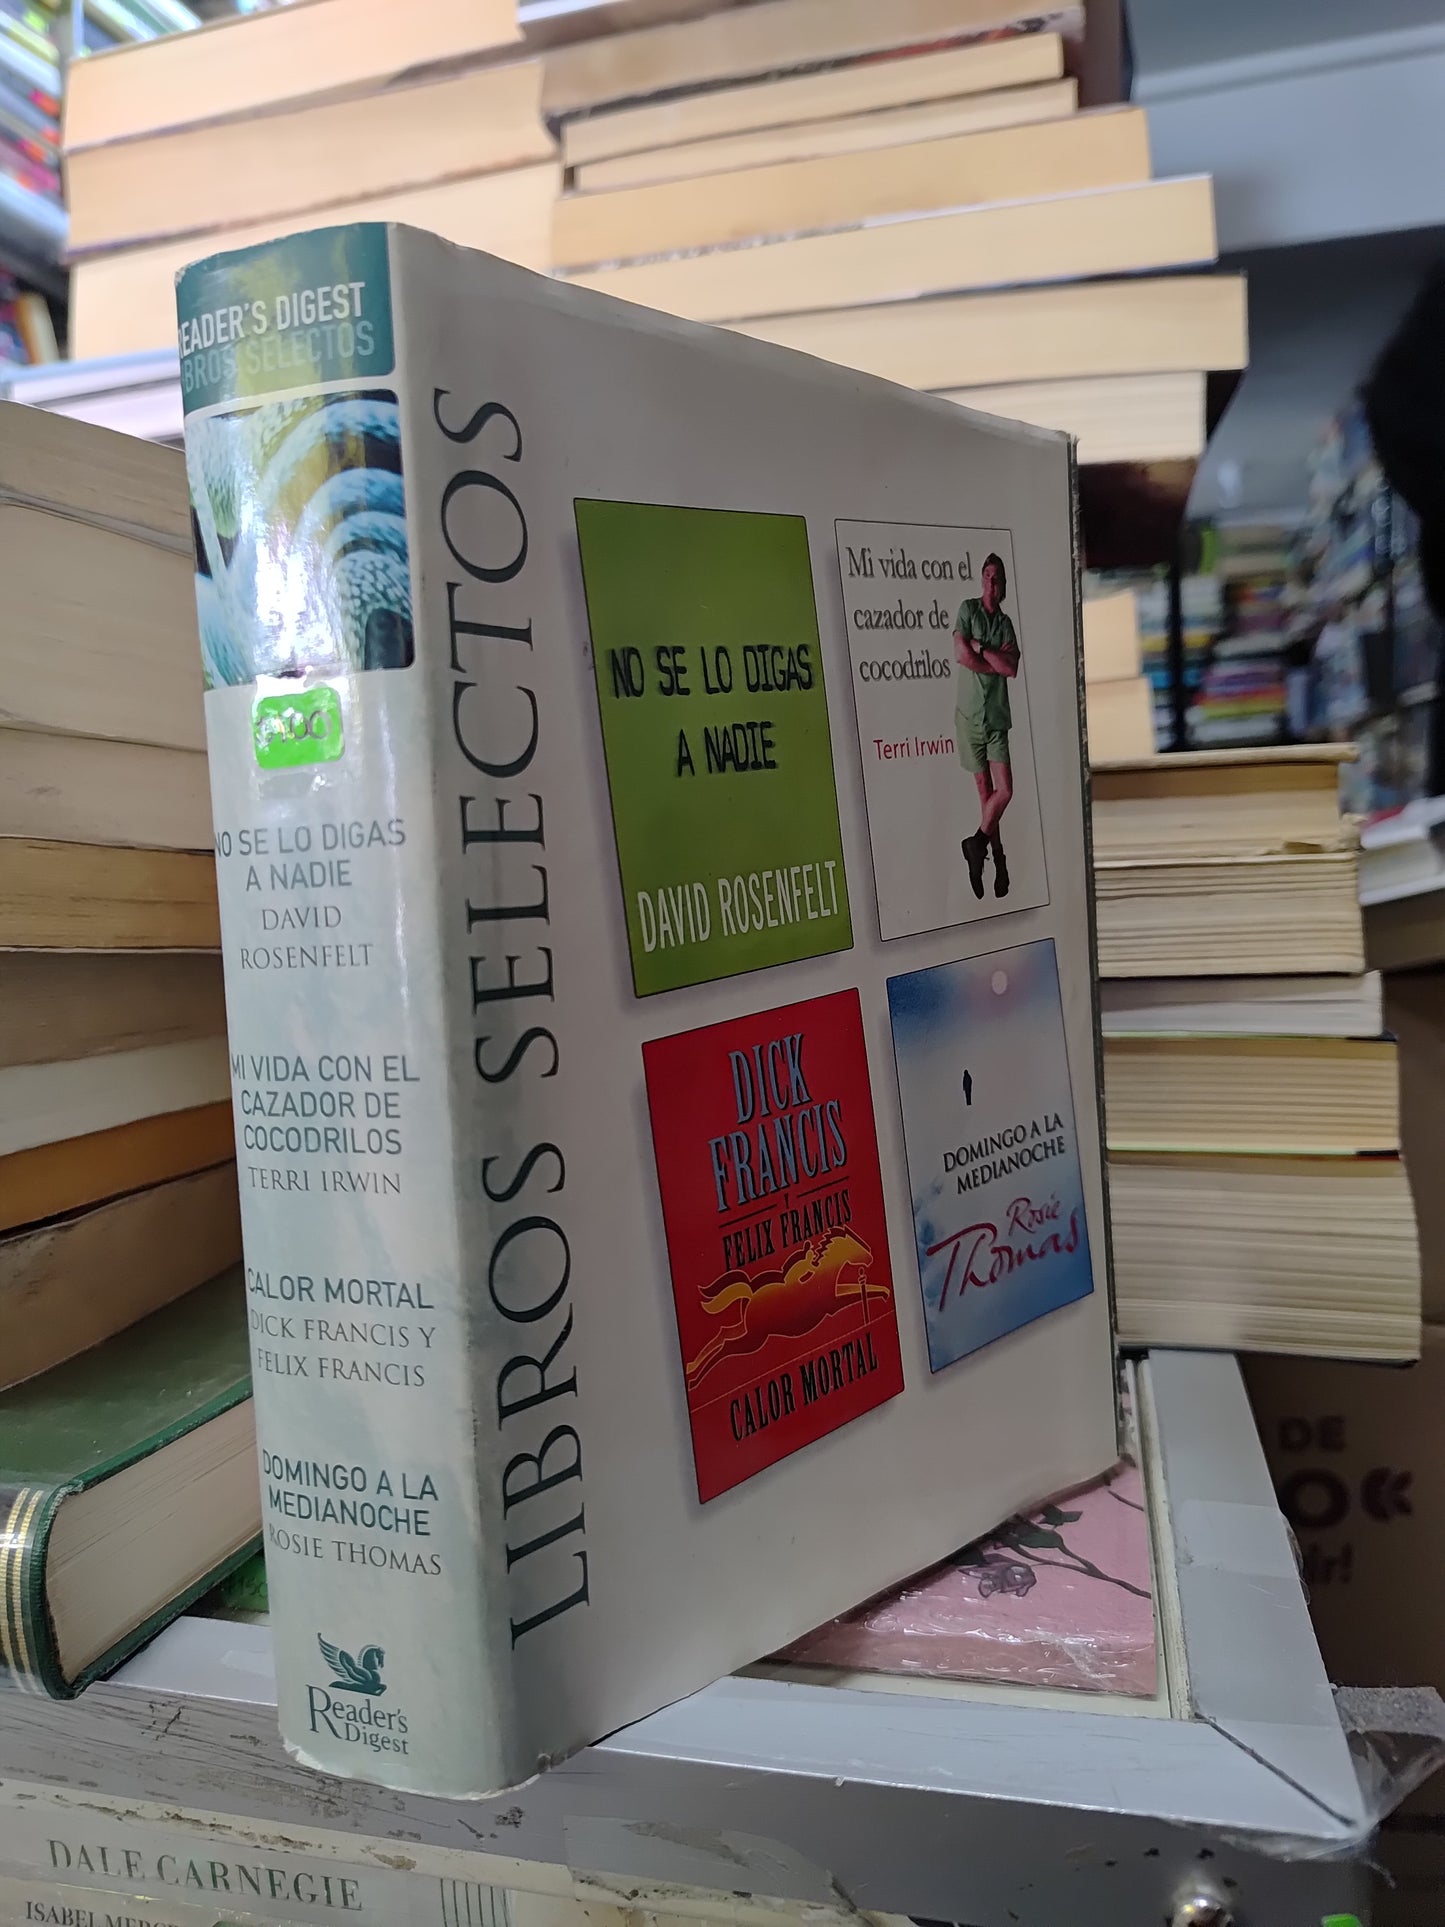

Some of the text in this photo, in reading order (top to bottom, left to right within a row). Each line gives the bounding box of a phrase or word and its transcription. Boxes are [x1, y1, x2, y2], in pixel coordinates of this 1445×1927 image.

[276, 281, 366, 330] DIGEST
[248, 320, 375, 375] SELECTOS
[845, 546, 973, 581] Mi vida con el
[853, 599, 950, 631] cazador de
[609, 643, 815, 699] NO SE LO DIGAS
[859, 650, 951, 683] cocodrilos
[677, 720, 777, 777] A NADIE
[873, 734, 955, 761] Terri Irwin
[215, 819, 406, 857] NO SE LO DIGAS
[246, 860, 353, 891] A NADIE
[262, 906, 342, 931] DAVID
[637, 859, 840, 954] DAVID ROSENFELT
[240, 944, 374, 970] ROSENFELT
[433, 387, 589, 1650] LIBROS SELECTOS
[231, 1054, 420, 1082] MI VIDA CON EL
[728, 1033, 814, 1126] DICK
[241, 1090, 401, 1119] CAZADOR DE
[244, 1124, 402, 1155] COCODRILOS
[707, 1098, 848, 1214] FRANCIS
[943, 1111, 1064, 1174] DOMINGO A LA
[248, 1166, 401, 1194] TERRI IRWIN
[956, 1135, 1066, 1195] MEDIANOCHE
[722, 1188, 852, 1272] FELIX FRANCIS
[1006, 1191, 1062, 1237] Rosie
[926, 1206, 1080, 1313] Thomas
[247, 1267, 435, 1310] CALOR MORTAL
[251, 1308, 437, 1349] DICK FRANCIS Y
[257, 1347, 426, 1388] FELIX FRANCIS
[730, 1333, 879, 1443] CALOR MORTAL
[1278, 1415, 1347, 1454] DE
[262, 1448, 439, 1502] DOMINGO A LA
[268, 1484, 431, 1537] MEDIANOCHE
[268, 1523, 442, 1576] ROSIE THOMAS
[305, 1683, 408, 1740] Reader's
[344, 1722, 409, 1755] Digest
[47, 1839, 364, 1911] DALE CARNEGIE
[26, 1901, 103, 1927] ISABEL
